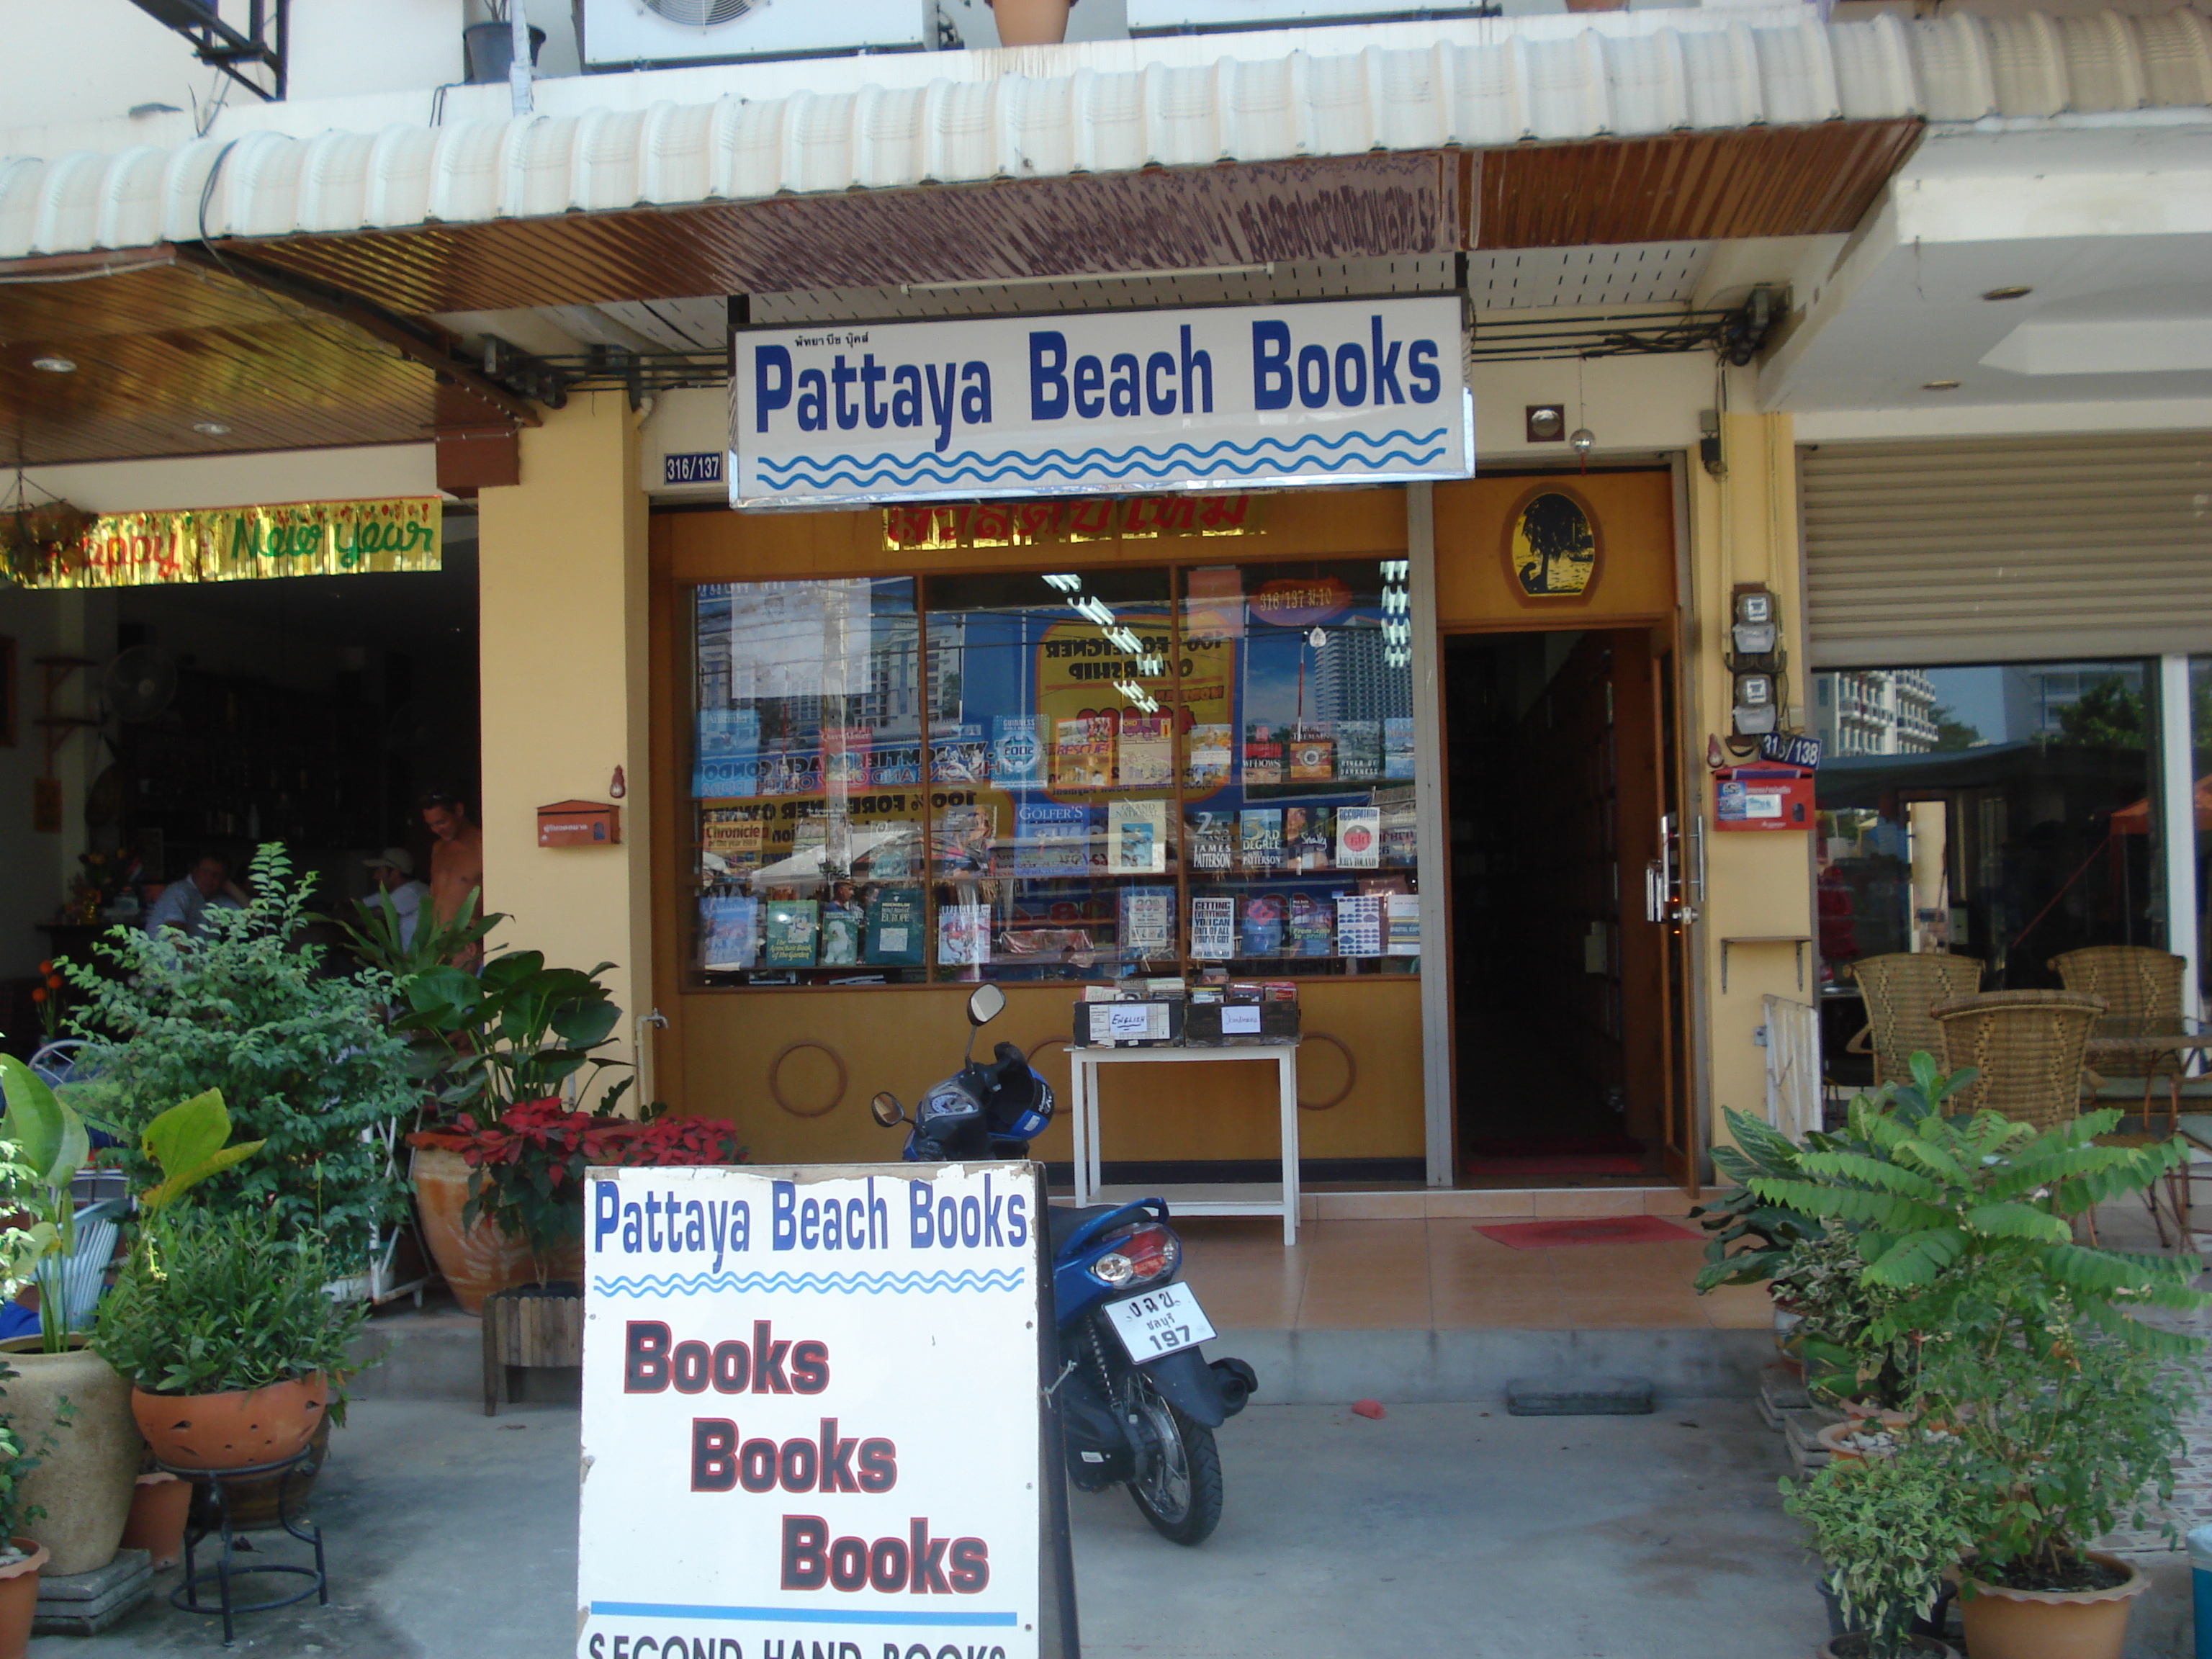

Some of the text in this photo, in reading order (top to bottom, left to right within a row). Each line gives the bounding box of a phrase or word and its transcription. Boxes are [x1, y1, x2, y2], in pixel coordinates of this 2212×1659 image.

[756, 315, 1441, 453] Pattaya Beach Books
[667, 455, 719, 480] 316/137
[230, 518, 322, 559] New
[1056, 744, 1110, 756] RESCUE!
[1019, 805, 1084, 820] GOLFER'S
[706, 824, 760, 839] Chronicle
[1243, 840, 1281, 850] DEGREE
[1193, 853, 1231, 868] PATTERSON
[1243, 856, 1282, 865] PATTERSON
[1112, 1014, 1146, 1025] ENGLISH
[594, 1173, 1028, 1274] Pattaya Beach Books
[1149, 1325, 1190, 1352] 197
[624, 1320, 830, 1395] Books
[690, 1417, 898, 1493] Books
[781, 1514, 990, 1594] Books
